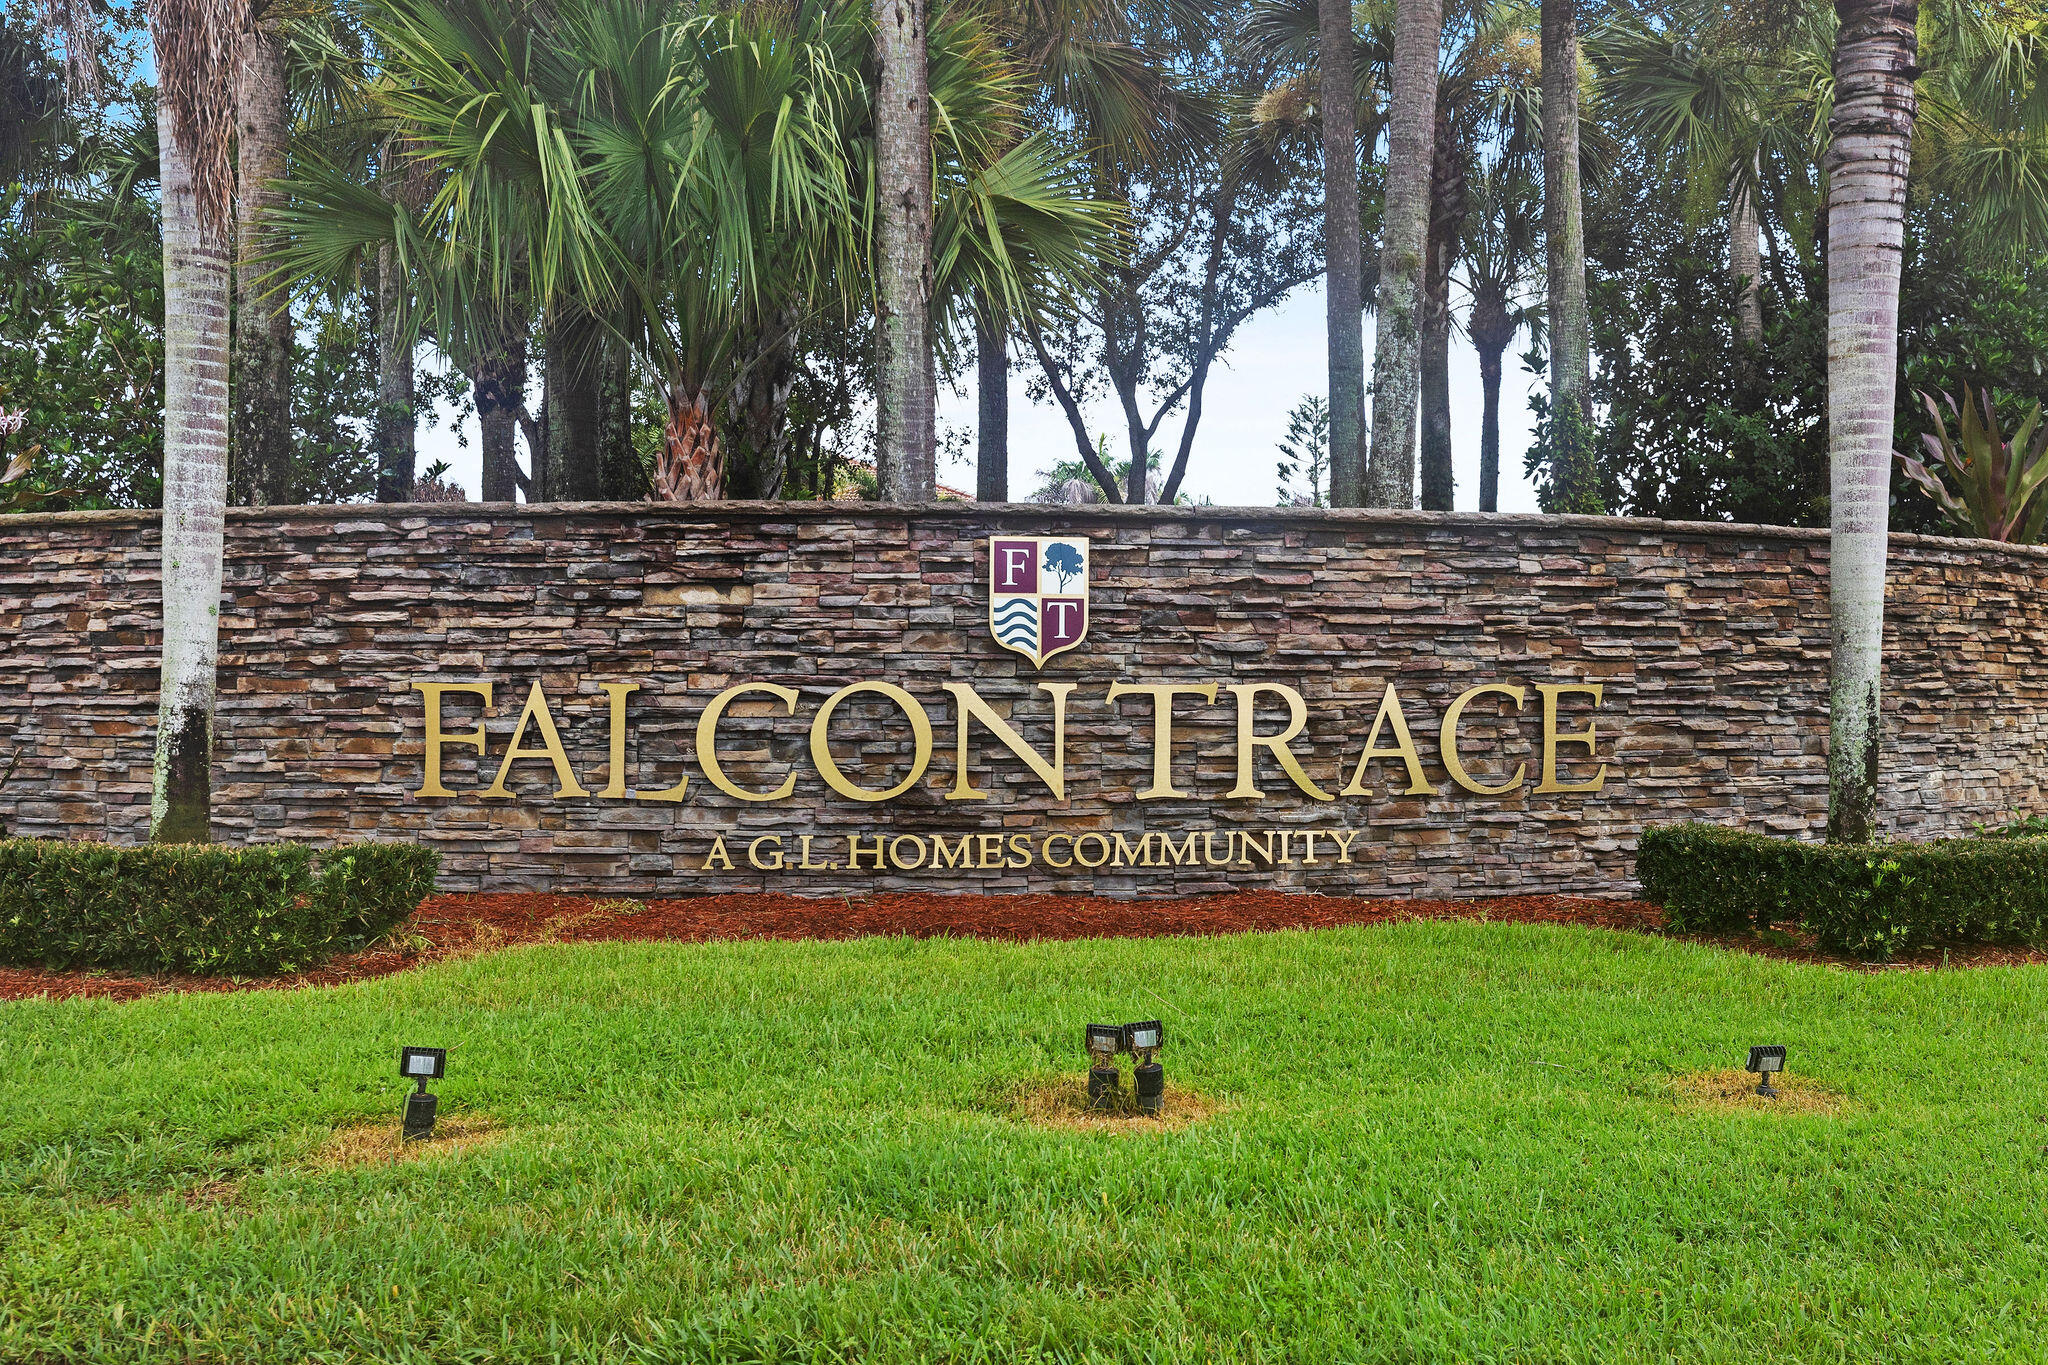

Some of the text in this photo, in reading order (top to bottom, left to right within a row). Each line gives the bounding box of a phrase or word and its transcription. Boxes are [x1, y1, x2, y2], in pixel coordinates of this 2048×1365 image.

[1001, 548, 1030, 586] F
[1046, 601, 1078, 639] T
[411, 681, 1607, 802] FALCON TRACE
[701, 834, 736, 870] A
[846, 832, 1033, 870] HOMES
[1042, 829, 1360, 867] COMMUNITY
